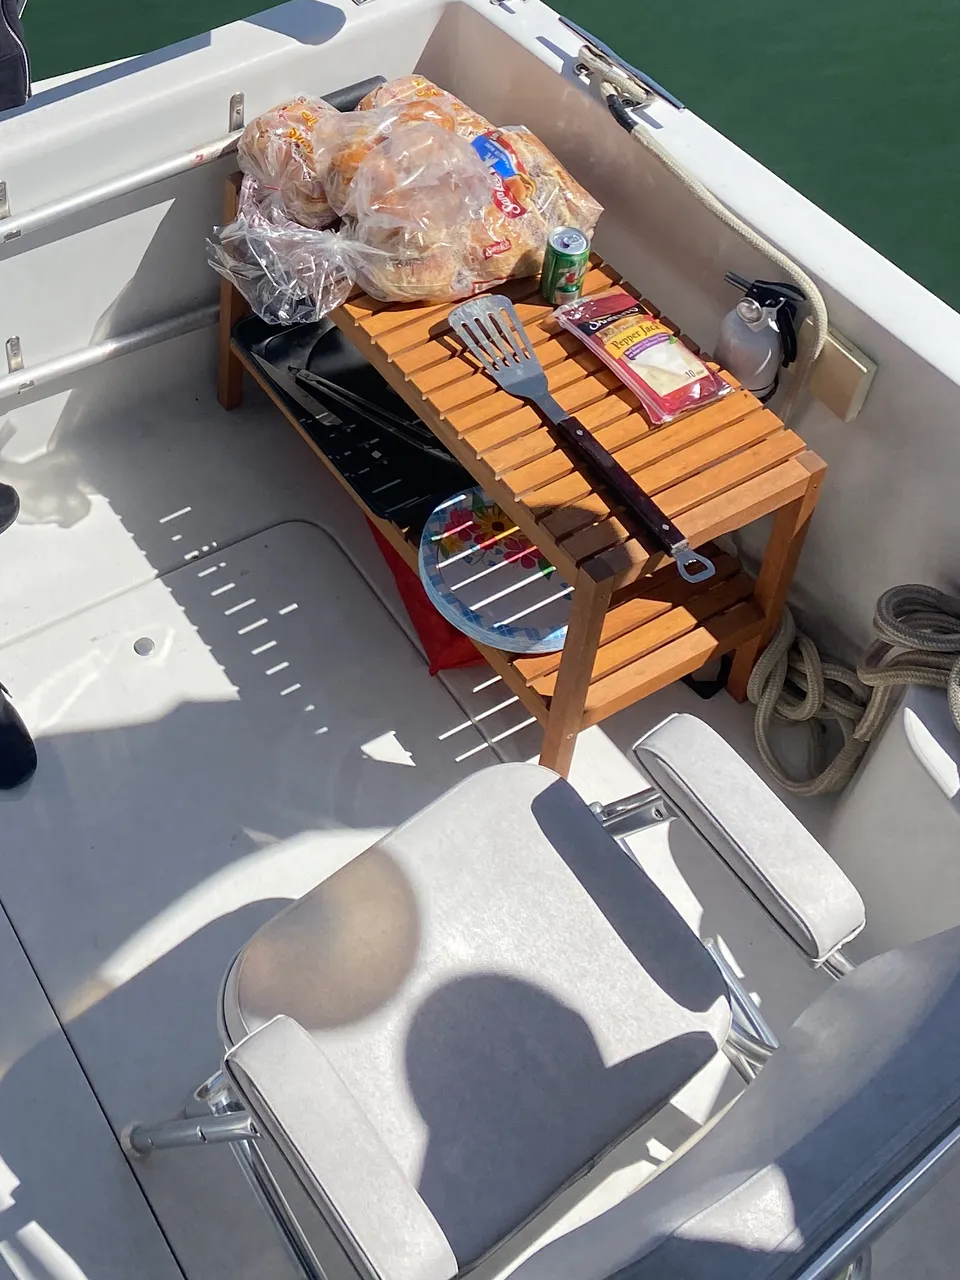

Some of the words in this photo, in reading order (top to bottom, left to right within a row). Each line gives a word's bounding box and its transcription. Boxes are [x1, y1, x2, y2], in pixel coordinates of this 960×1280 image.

[611, 331, 641, 350] Pepper
[639, 323, 661, 337] Jack
[685, 369, 696, 378] 10
